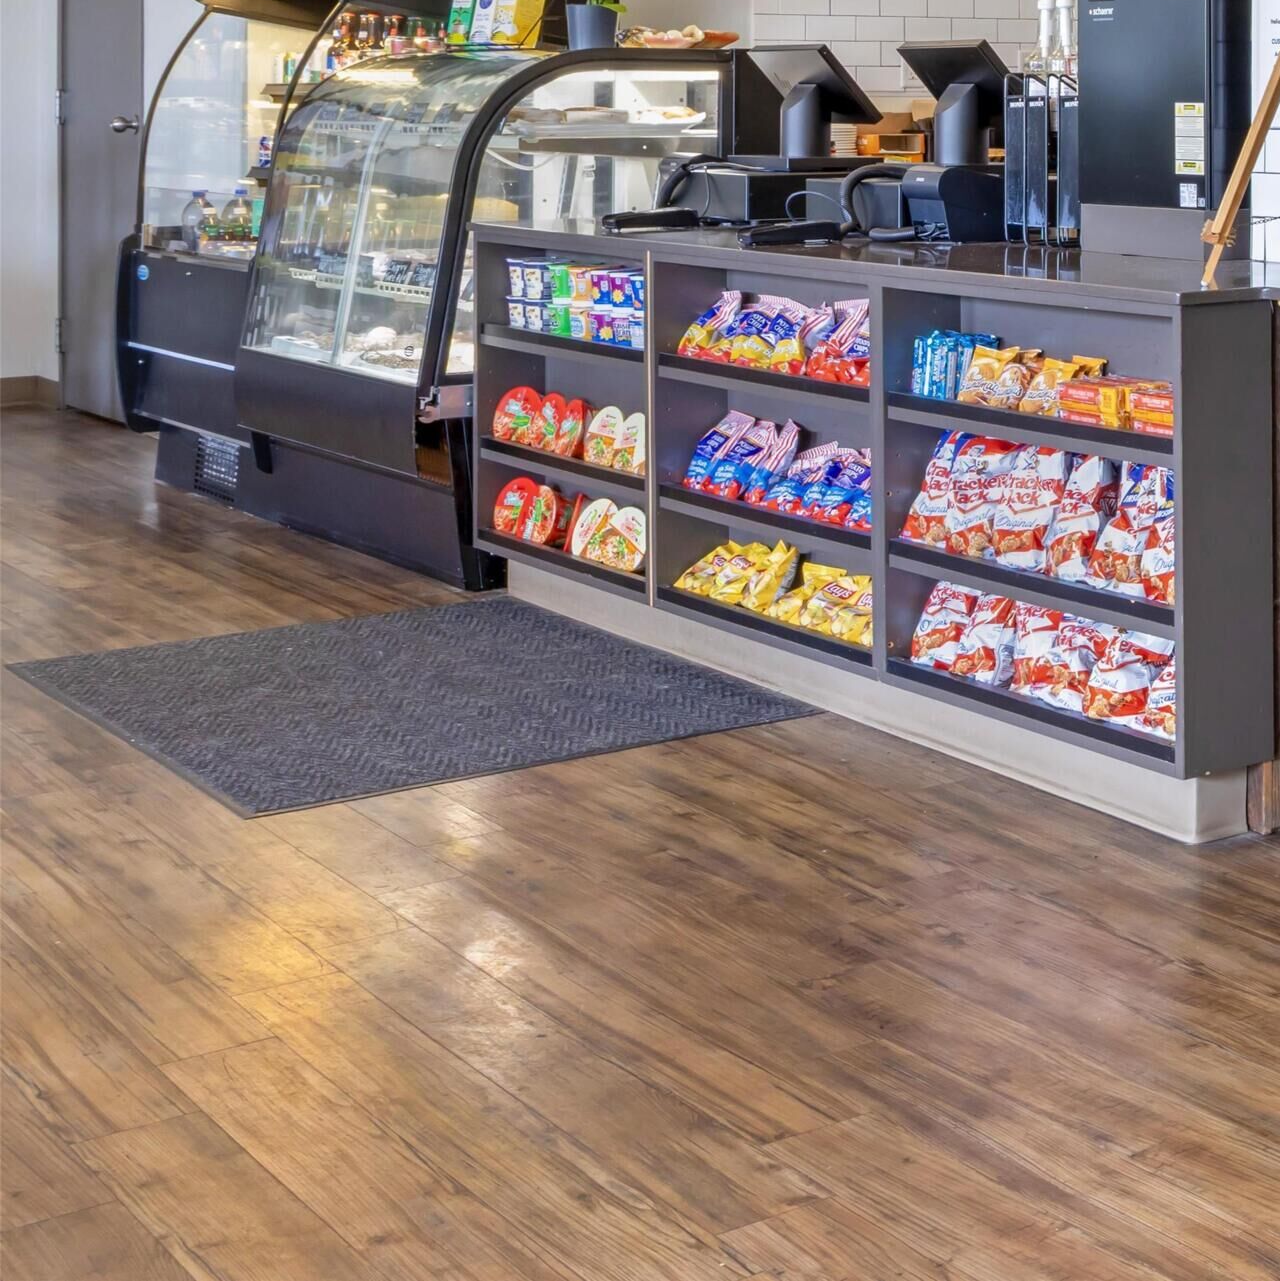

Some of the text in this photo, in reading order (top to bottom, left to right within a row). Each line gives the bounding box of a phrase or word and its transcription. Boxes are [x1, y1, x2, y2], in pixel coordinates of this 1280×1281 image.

[952, 473, 1007, 491] racker
[1008, 476, 1055, 493] racker
[953, 489, 990, 504] Jack
[995, 517, 1035, 529] Original
